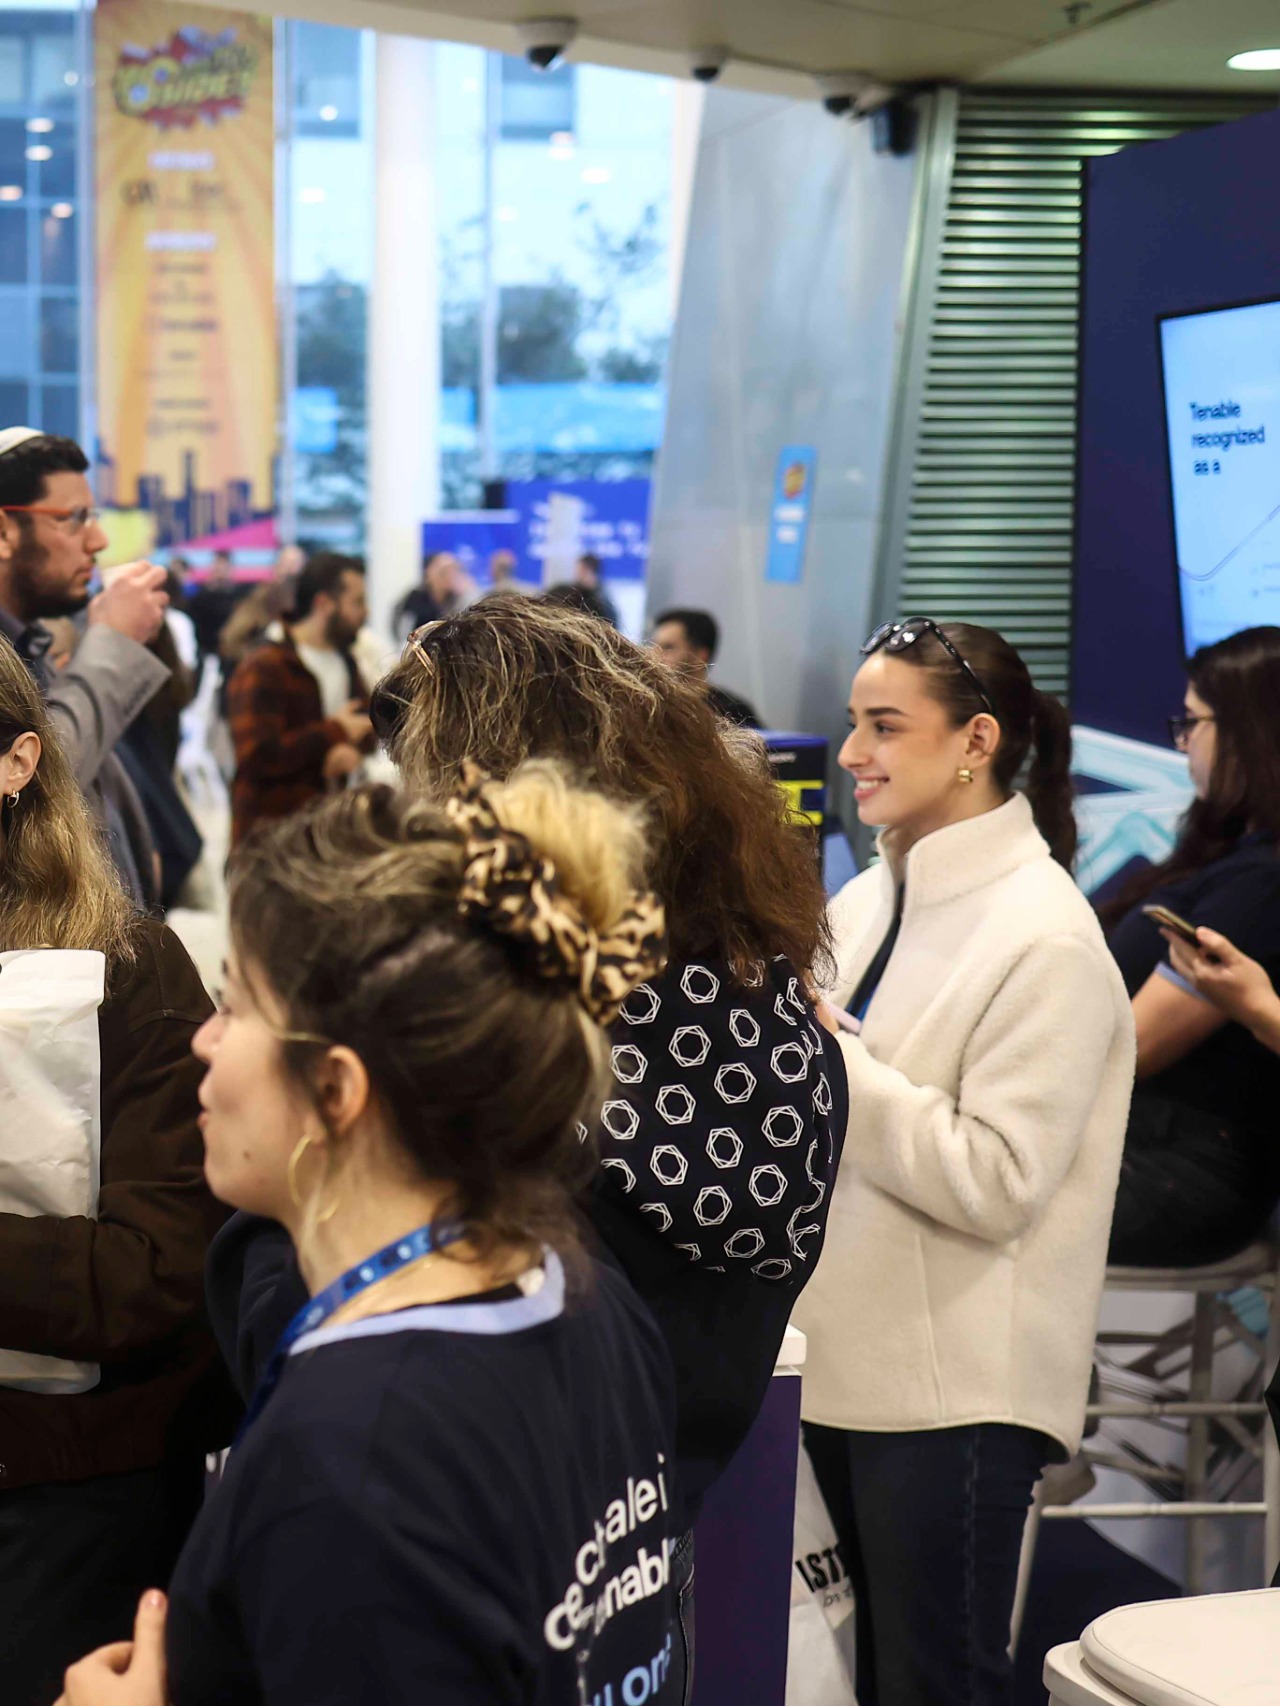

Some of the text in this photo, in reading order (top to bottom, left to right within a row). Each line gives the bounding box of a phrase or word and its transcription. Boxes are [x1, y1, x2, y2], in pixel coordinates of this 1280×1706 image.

[1190, 400, 1241, 420] Tenable
[1192, 425, 1265, 450] recognized
[1194, 460, 1221, 475] as a
